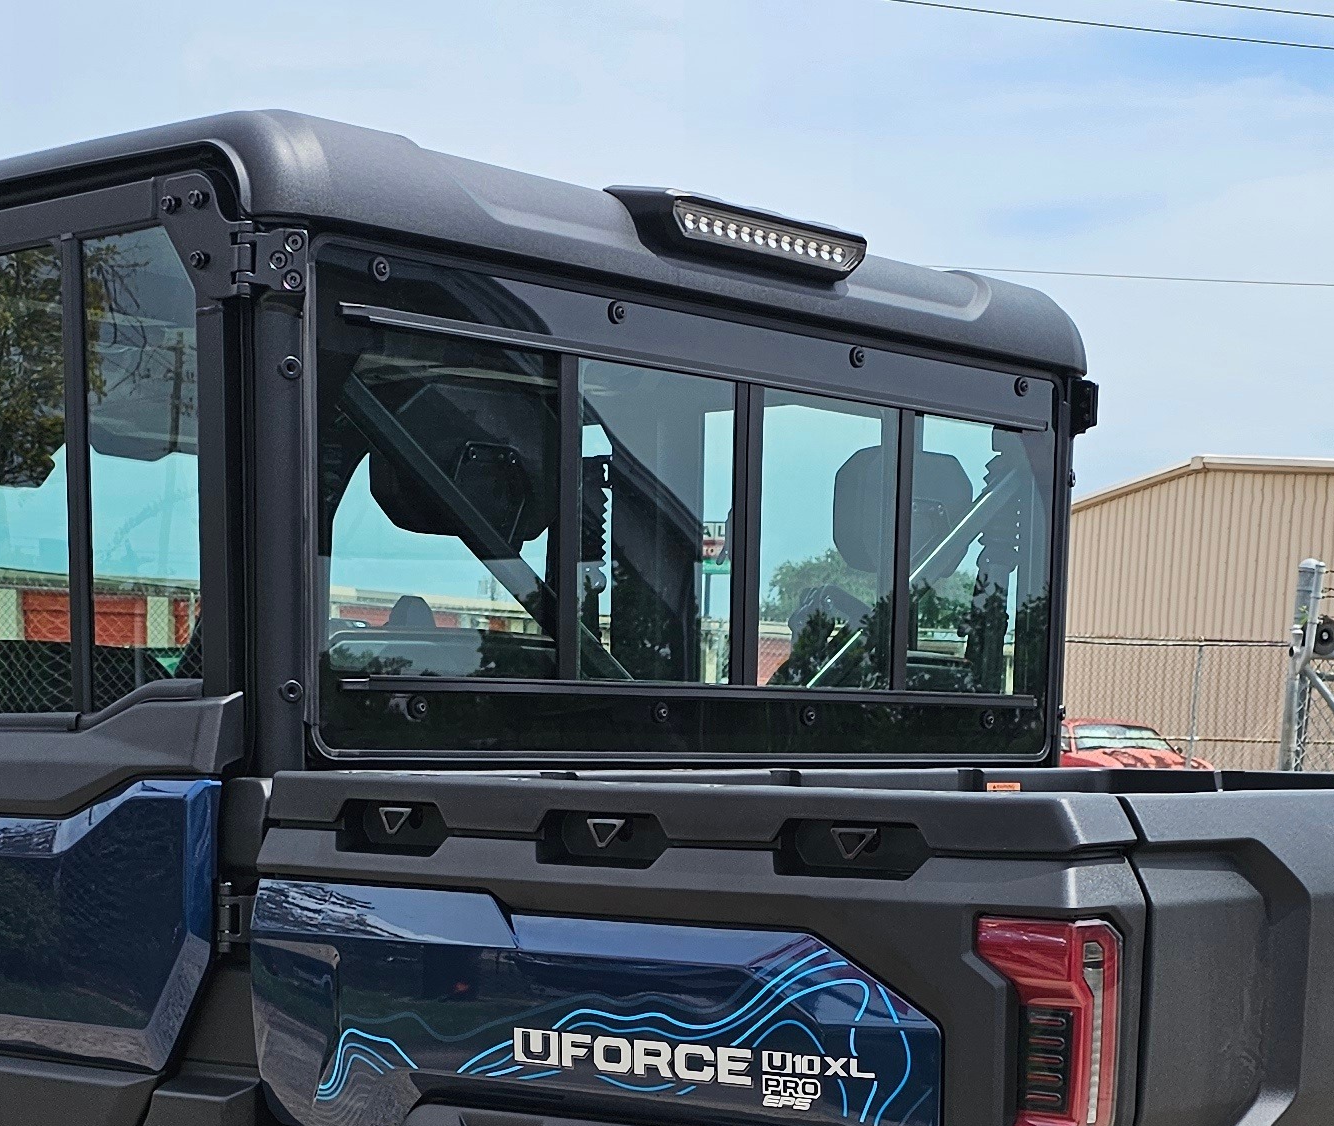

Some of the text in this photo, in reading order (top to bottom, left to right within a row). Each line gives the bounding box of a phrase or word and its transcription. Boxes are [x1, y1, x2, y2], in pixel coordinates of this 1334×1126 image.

[513, 1027, 753, 1087] UFORCE
[762, 1075, 821, 1099] PRO
[762, 1096, 813, 1111] EPS
